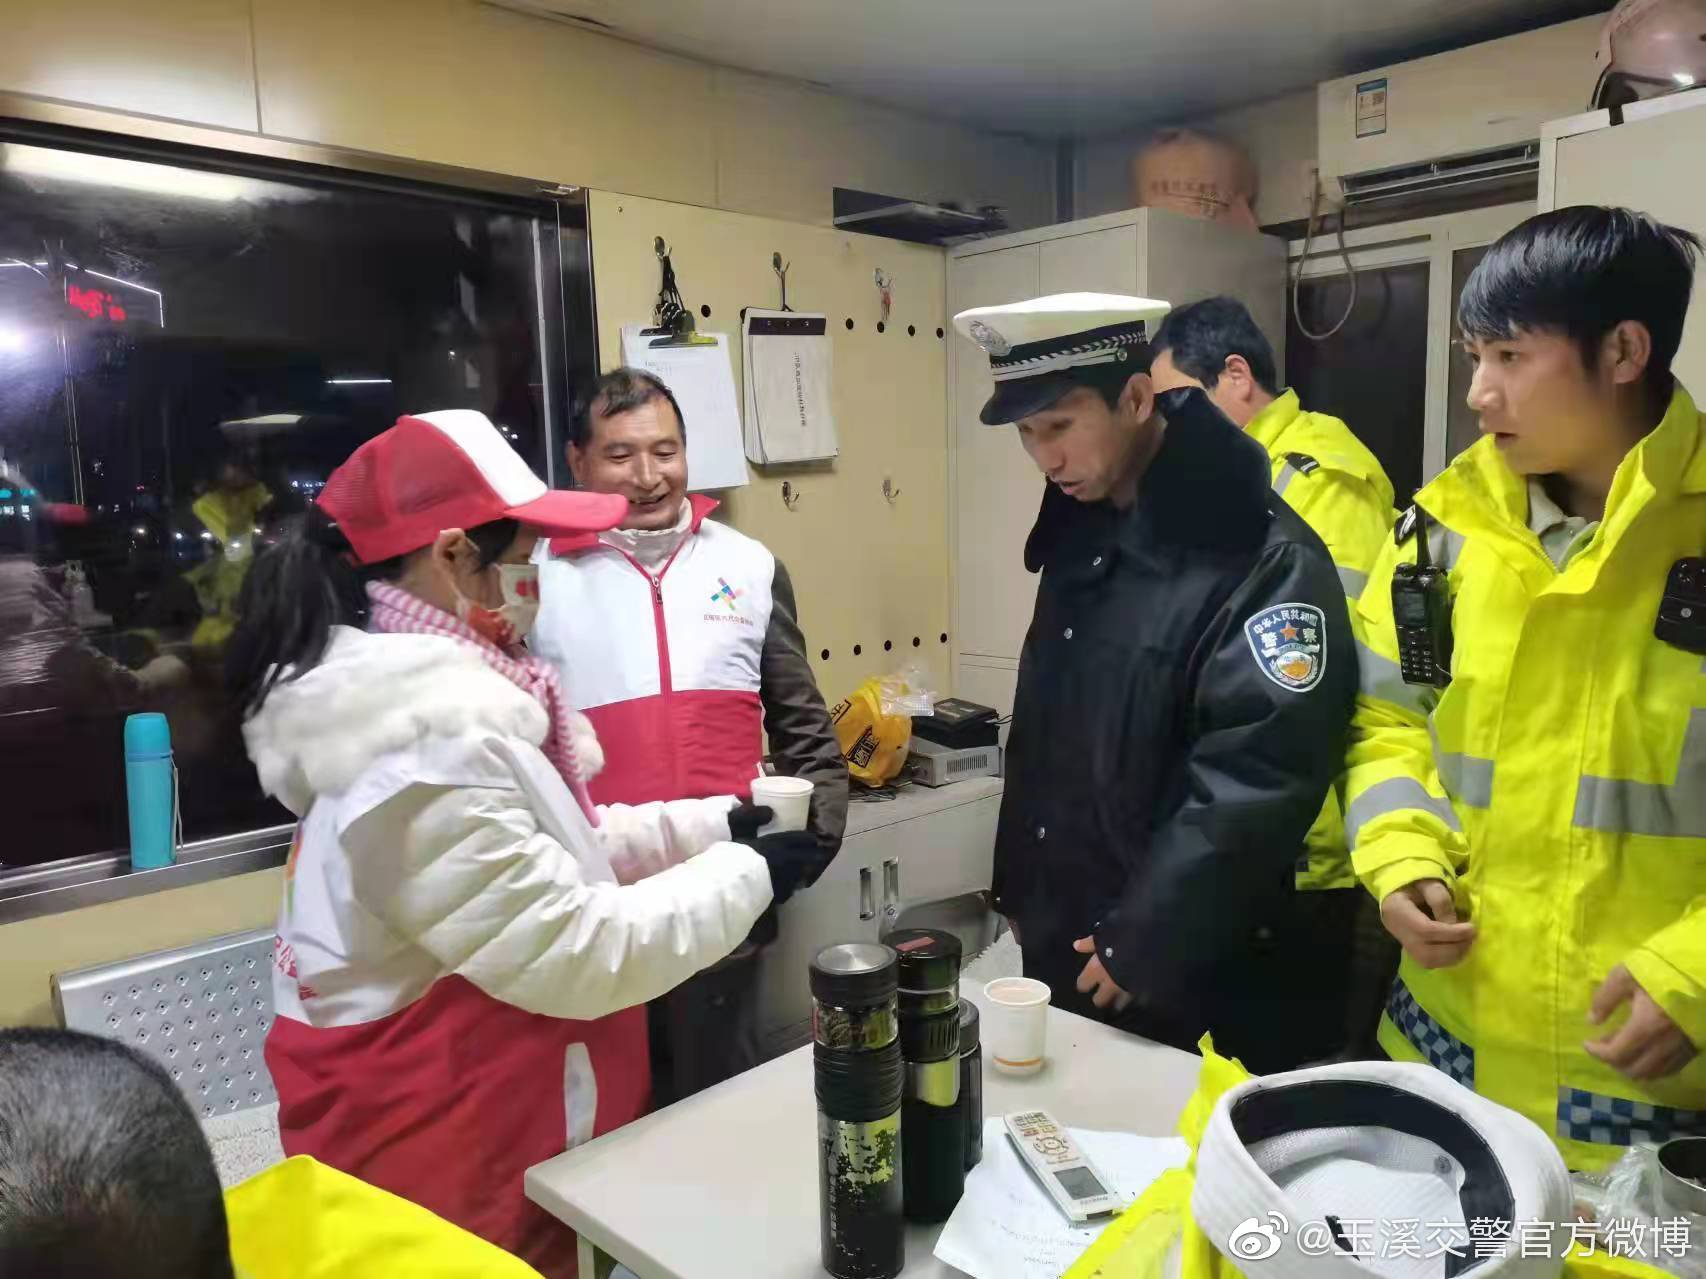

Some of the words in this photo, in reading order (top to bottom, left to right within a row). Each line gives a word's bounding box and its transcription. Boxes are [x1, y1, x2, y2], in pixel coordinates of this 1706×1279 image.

[1253, 608, 1319, 634] 中华人民共和国
